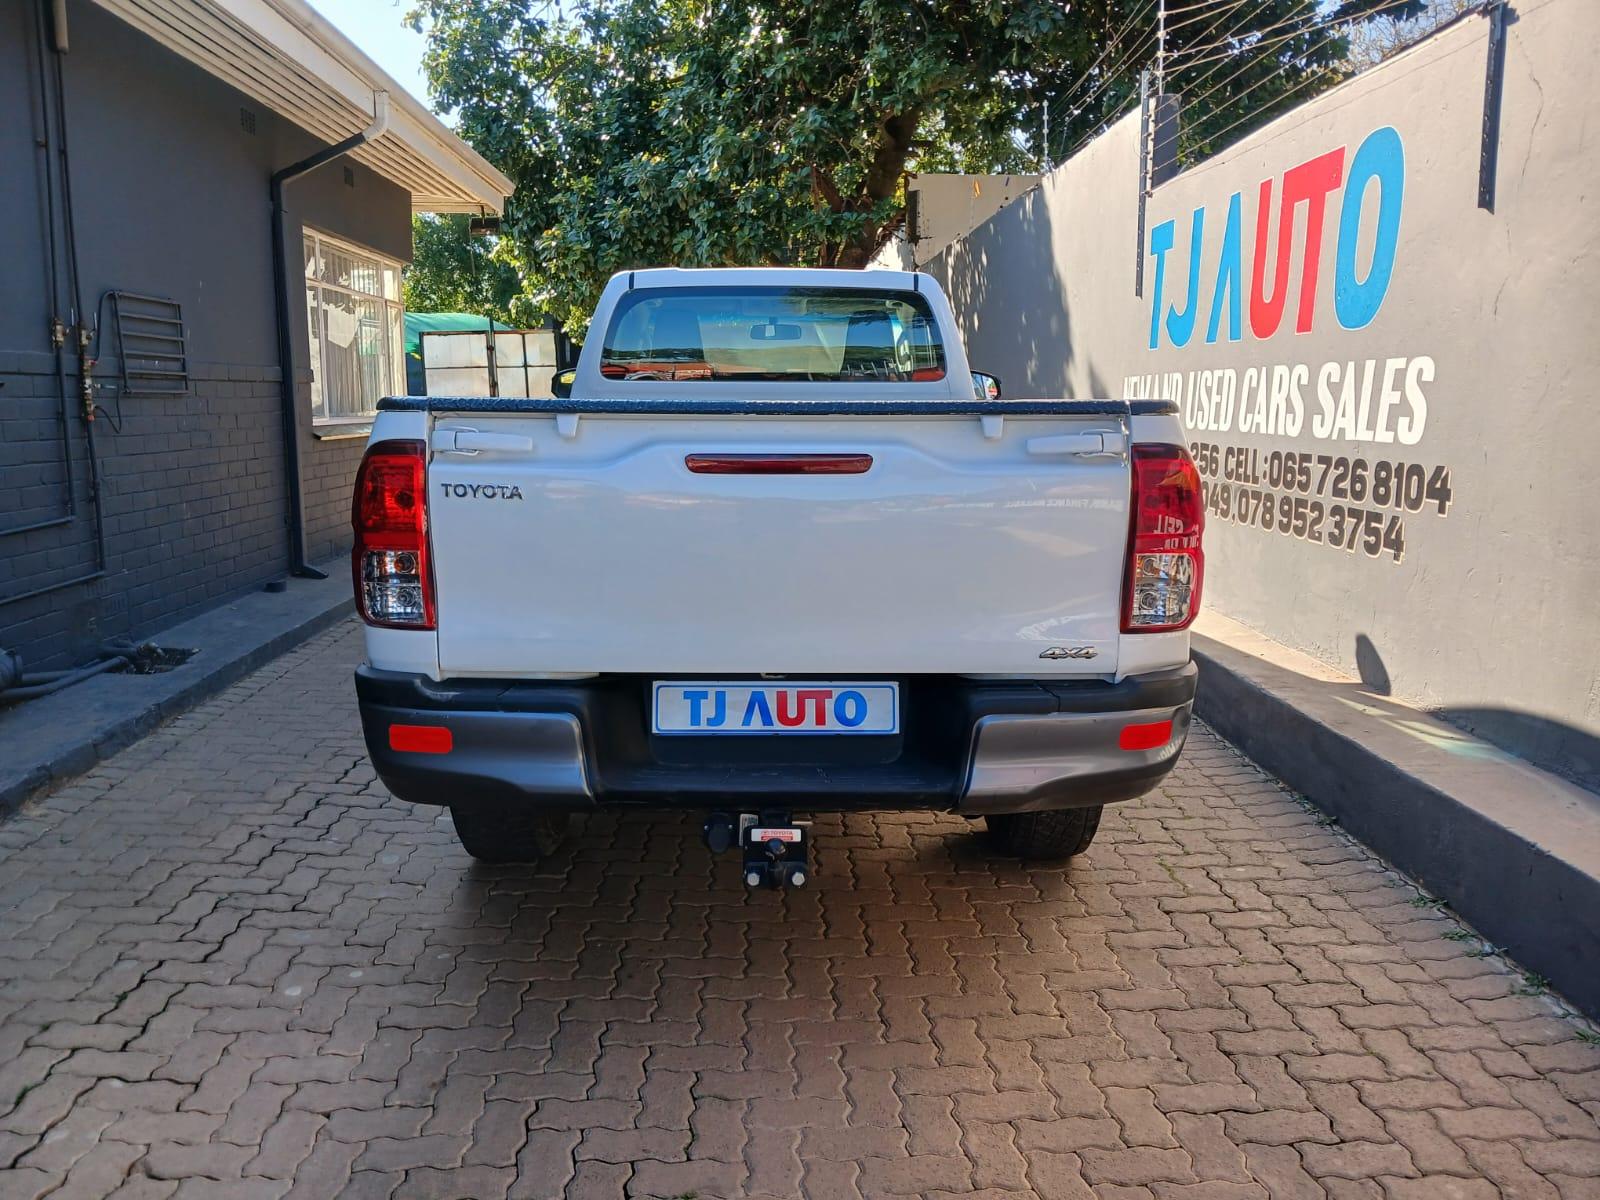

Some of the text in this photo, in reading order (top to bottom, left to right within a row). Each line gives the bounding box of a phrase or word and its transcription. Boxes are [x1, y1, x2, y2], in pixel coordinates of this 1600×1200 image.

[1149, 125, 1405, 350] TJ AUTO
[1185, 368, 1237, 432] USED
[1238, 363, 1309, 438] CARS
[1312, 355, 1436, 445] SALES
[440, 482, 524, 500] TOYOTA
[1316, 454, 1369, 503] 726
[1372, 460, 1453, 517] 8104
[1278, 494, 1325, 545] 952
[1327, 504, 1406, 565] 3754
[683, 689, 868, 728] TJ AUTO
